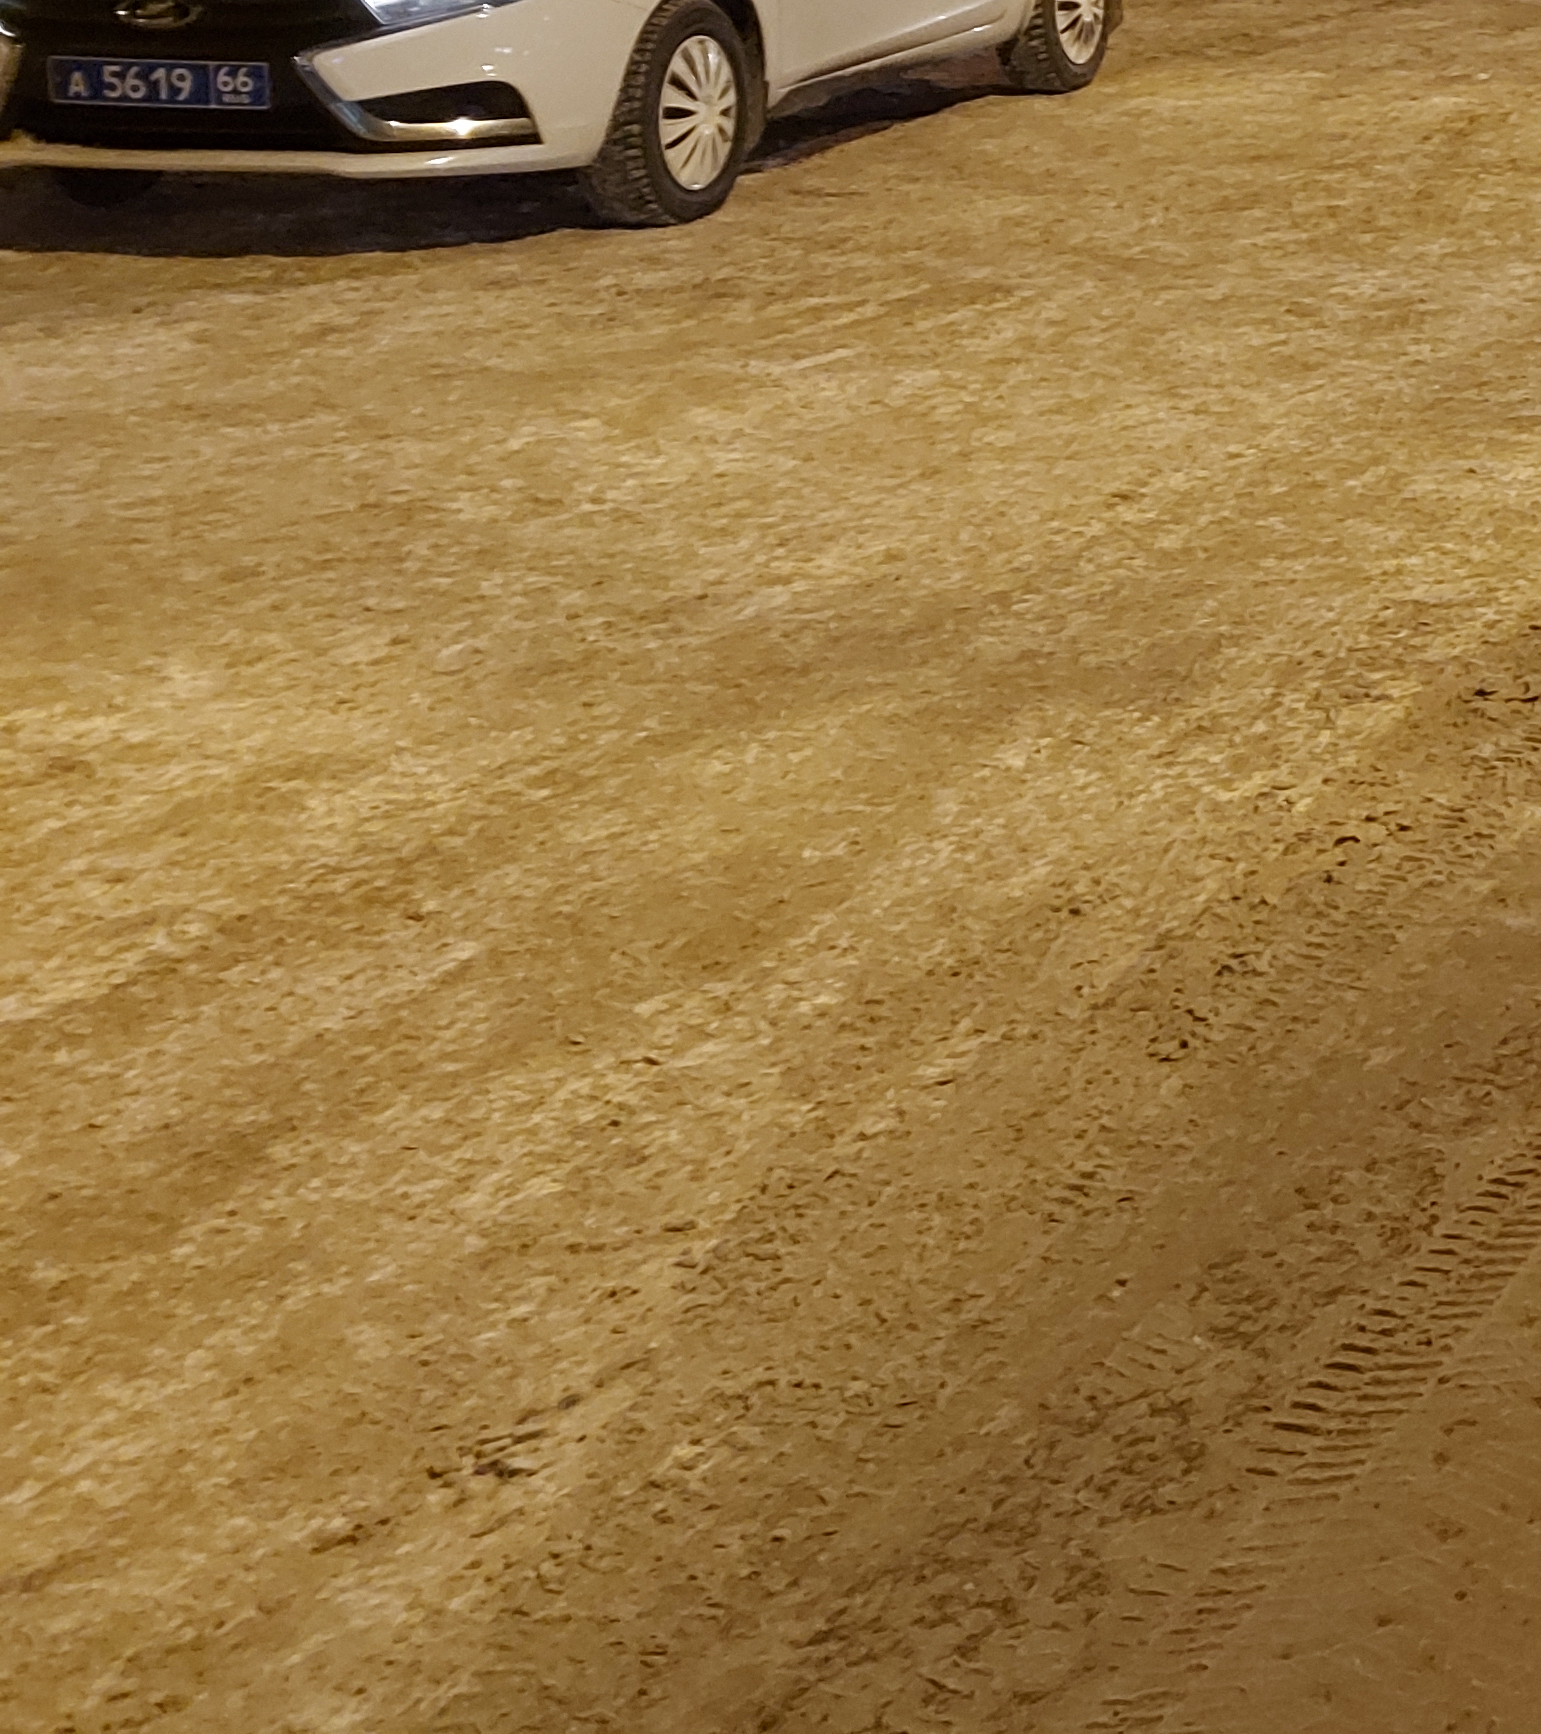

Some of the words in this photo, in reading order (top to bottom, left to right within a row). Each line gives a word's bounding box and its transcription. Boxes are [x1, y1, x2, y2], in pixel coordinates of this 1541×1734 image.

[68, 71, 90, 97] А
[102, 65, 193, 100] 5619
[216, 66, 253, 92] 66
